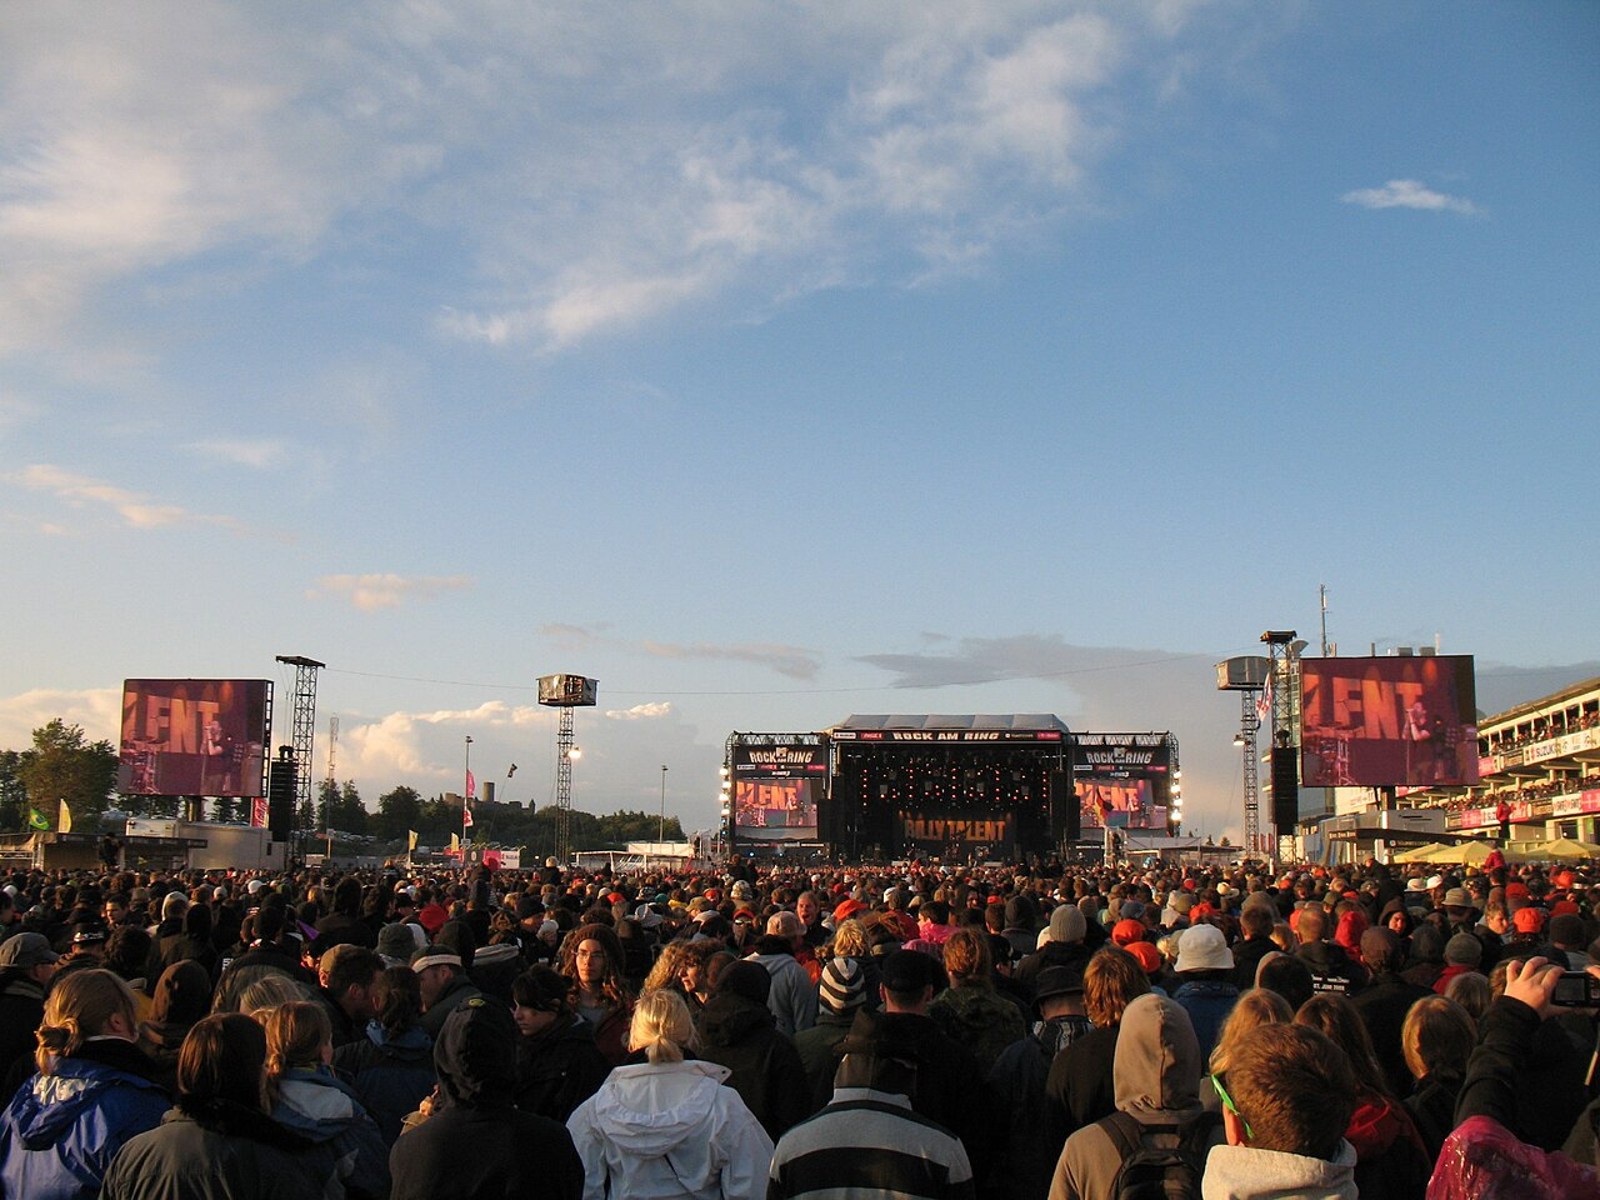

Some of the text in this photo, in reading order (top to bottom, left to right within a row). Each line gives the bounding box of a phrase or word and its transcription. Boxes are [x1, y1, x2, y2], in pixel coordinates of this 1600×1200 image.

[892, 732, 933, 741] ROCK
[937, 732, 959, 741] AM
[964, 731, 999, 741] RING
[749, 751, 777, 763] ROCK
[787, 751, 813, 763] RING
[1086, 752, 1115, 764] ROCK
[1126, 753, 1152, 764] RING
[904, 819, 945, 840] BILLY
